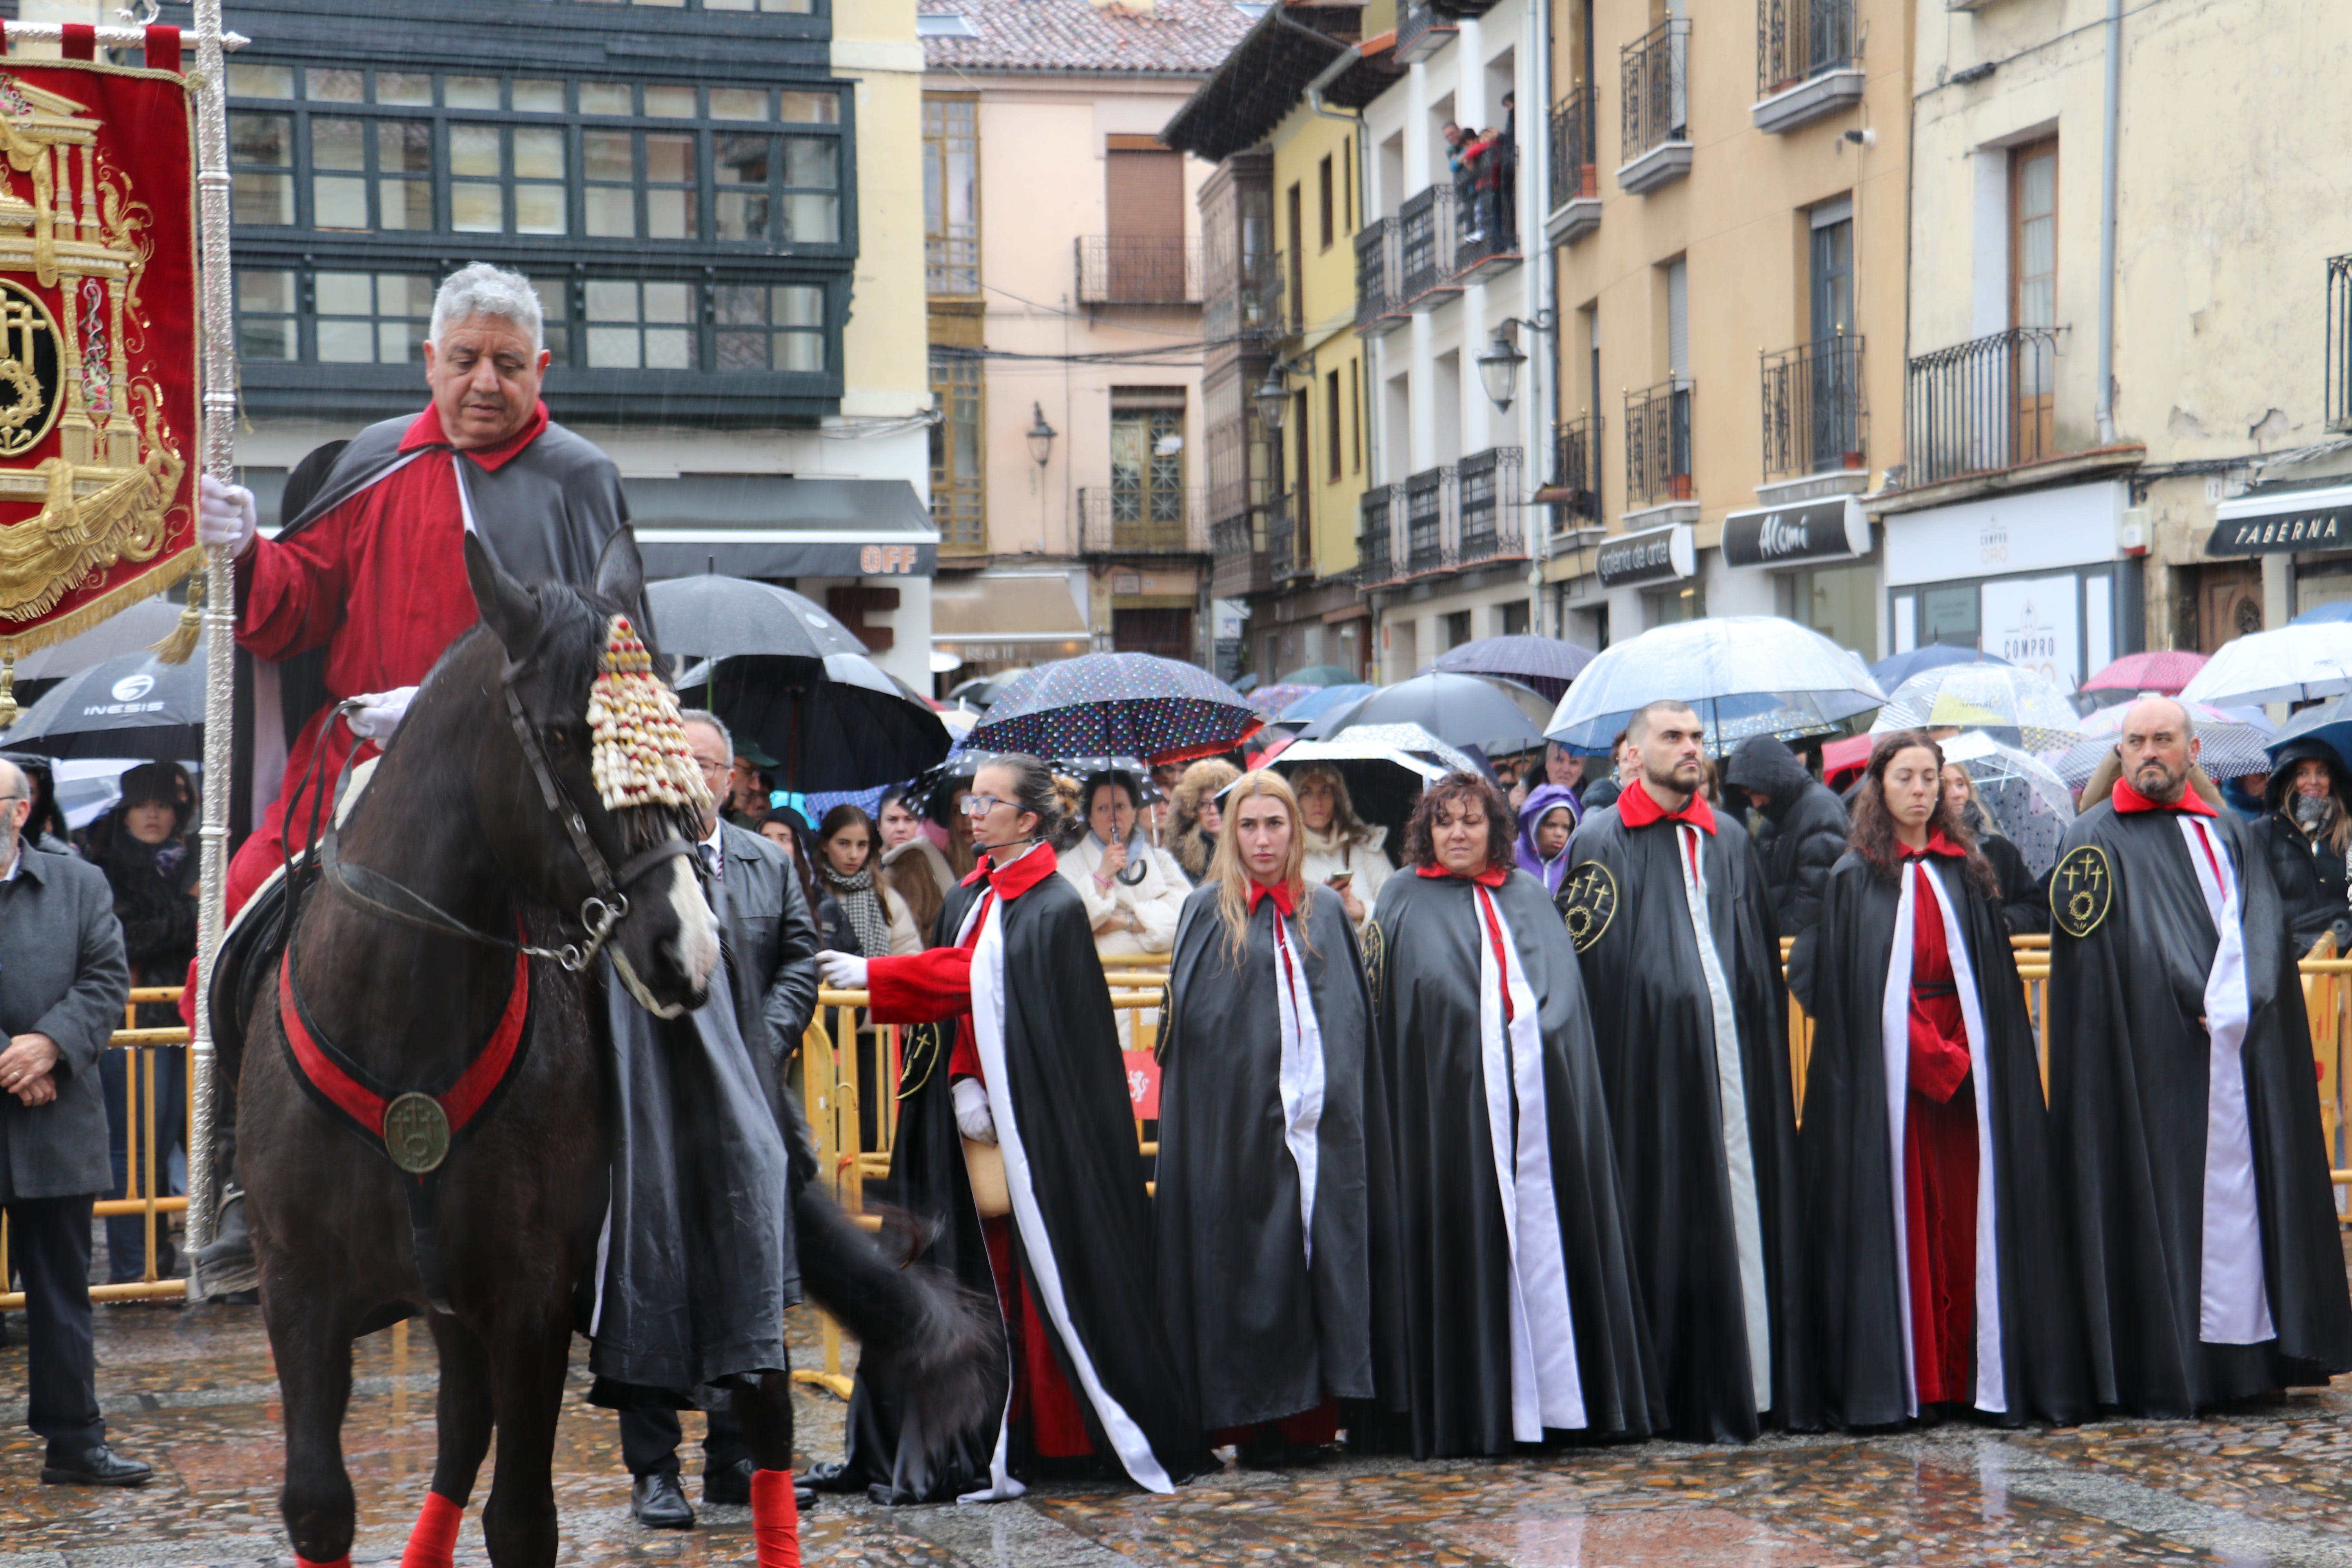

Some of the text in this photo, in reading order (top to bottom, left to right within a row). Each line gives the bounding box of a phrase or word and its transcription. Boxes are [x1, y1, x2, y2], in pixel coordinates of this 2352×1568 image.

[2209, 484, 2219, 499] 12
[1980, 532, 2007, 546] COMPRO
[2234, 515, 2337, 545] TABERNA
[860, 545, 917, 574] OFF
[1633, 543, 1646, 568] de
[1647, 539, 1668, 566] arte
[1981, 546, 2008, 564] ORO
[2004, 637, 2054, 659] COMPRO
[83, 701, 165, 716] INESIS
